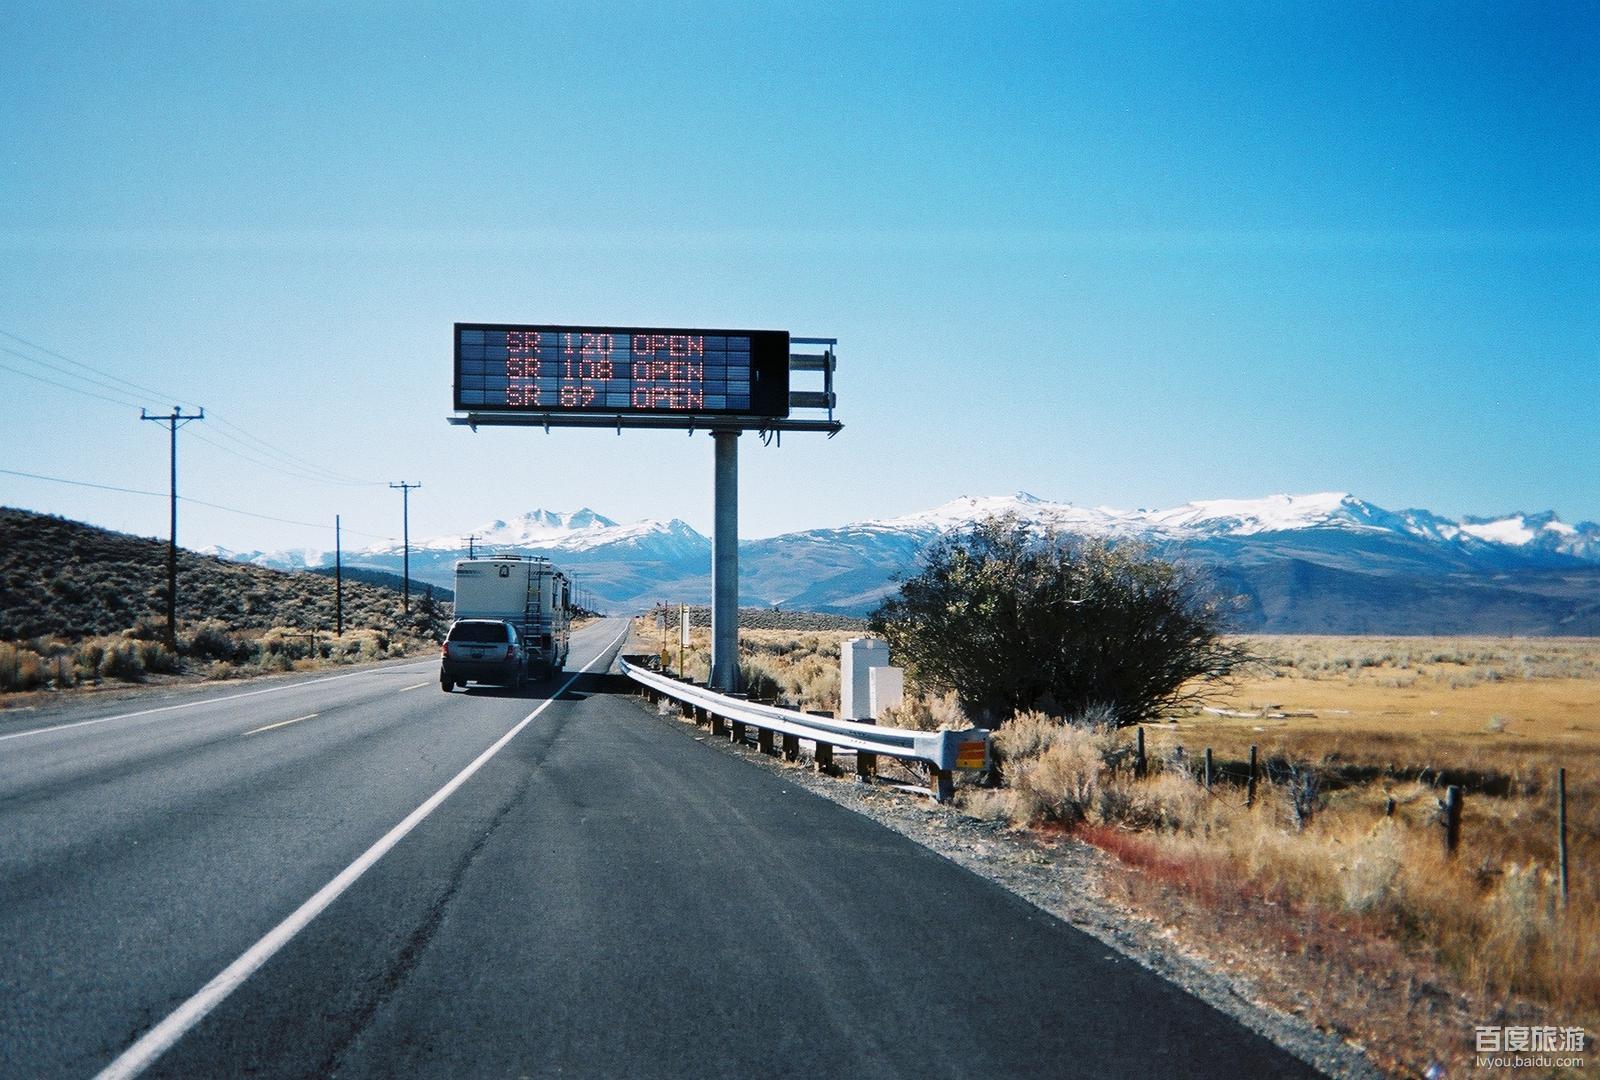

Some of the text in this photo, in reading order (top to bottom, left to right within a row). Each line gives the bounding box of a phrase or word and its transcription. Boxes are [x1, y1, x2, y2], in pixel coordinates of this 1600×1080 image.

[506, 331, 703, 357] SR 120 OPEN
[506, 358, 703, 383] SR 108 OPEN
[506, 385, 703, 409] SR 89 OPEN
